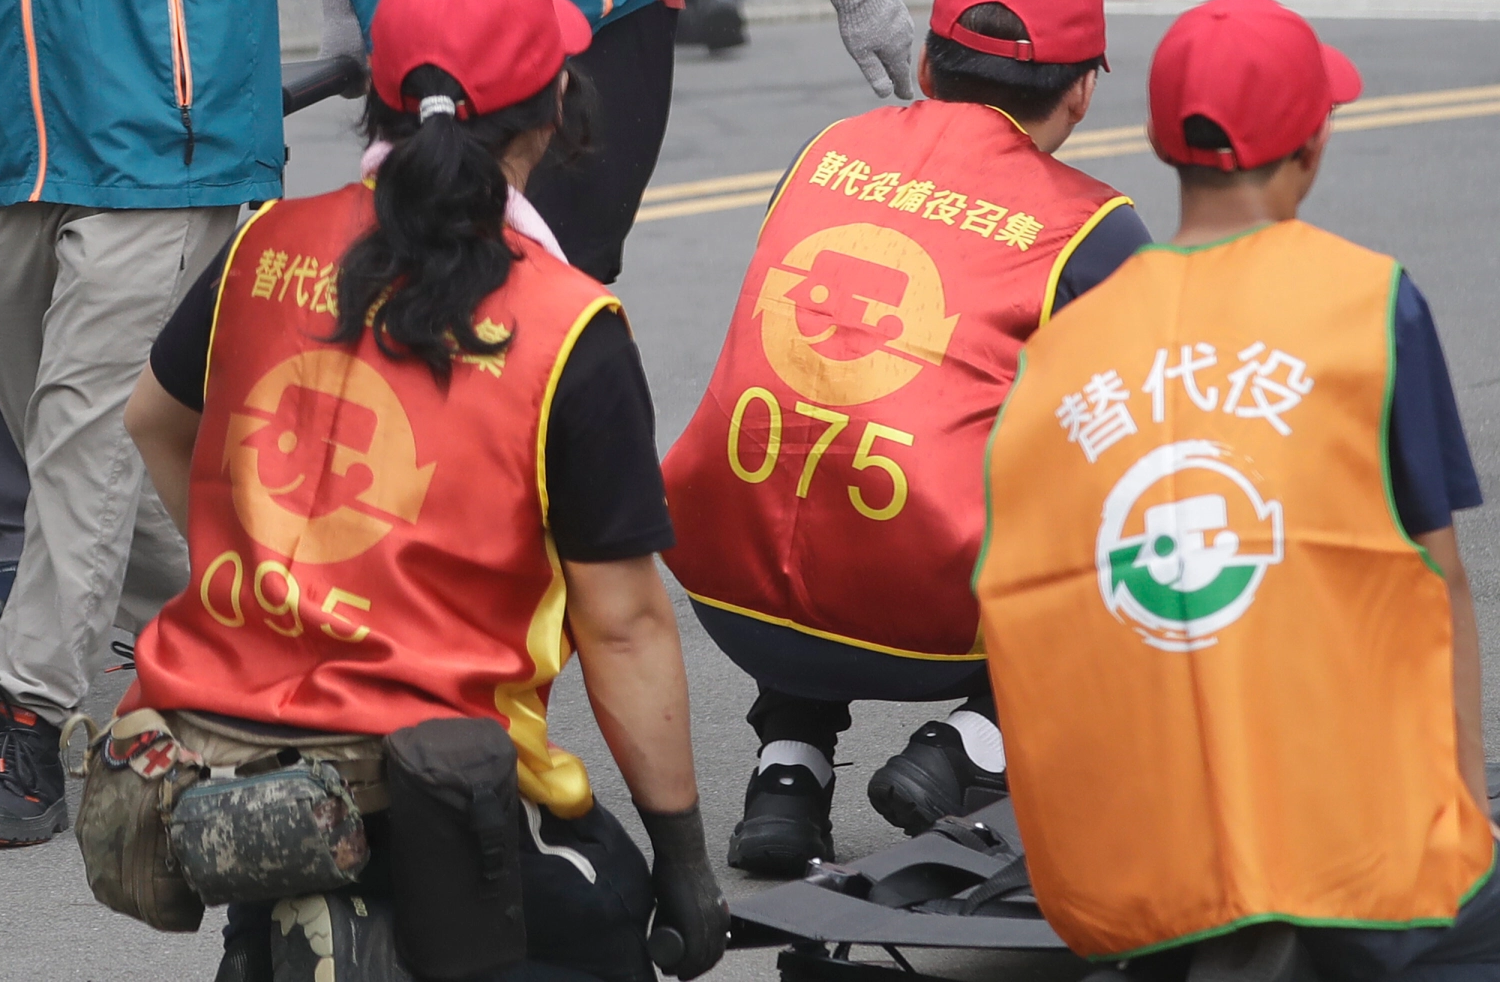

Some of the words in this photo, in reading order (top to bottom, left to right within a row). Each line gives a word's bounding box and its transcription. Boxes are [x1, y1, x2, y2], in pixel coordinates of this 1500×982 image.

[808, 149, 1046, 252] 替代役備役召集
[727, 386, 915, 522] 075
[1054, 340, 1316, 464] 替代役
[200, 549, 372, 643] 095
